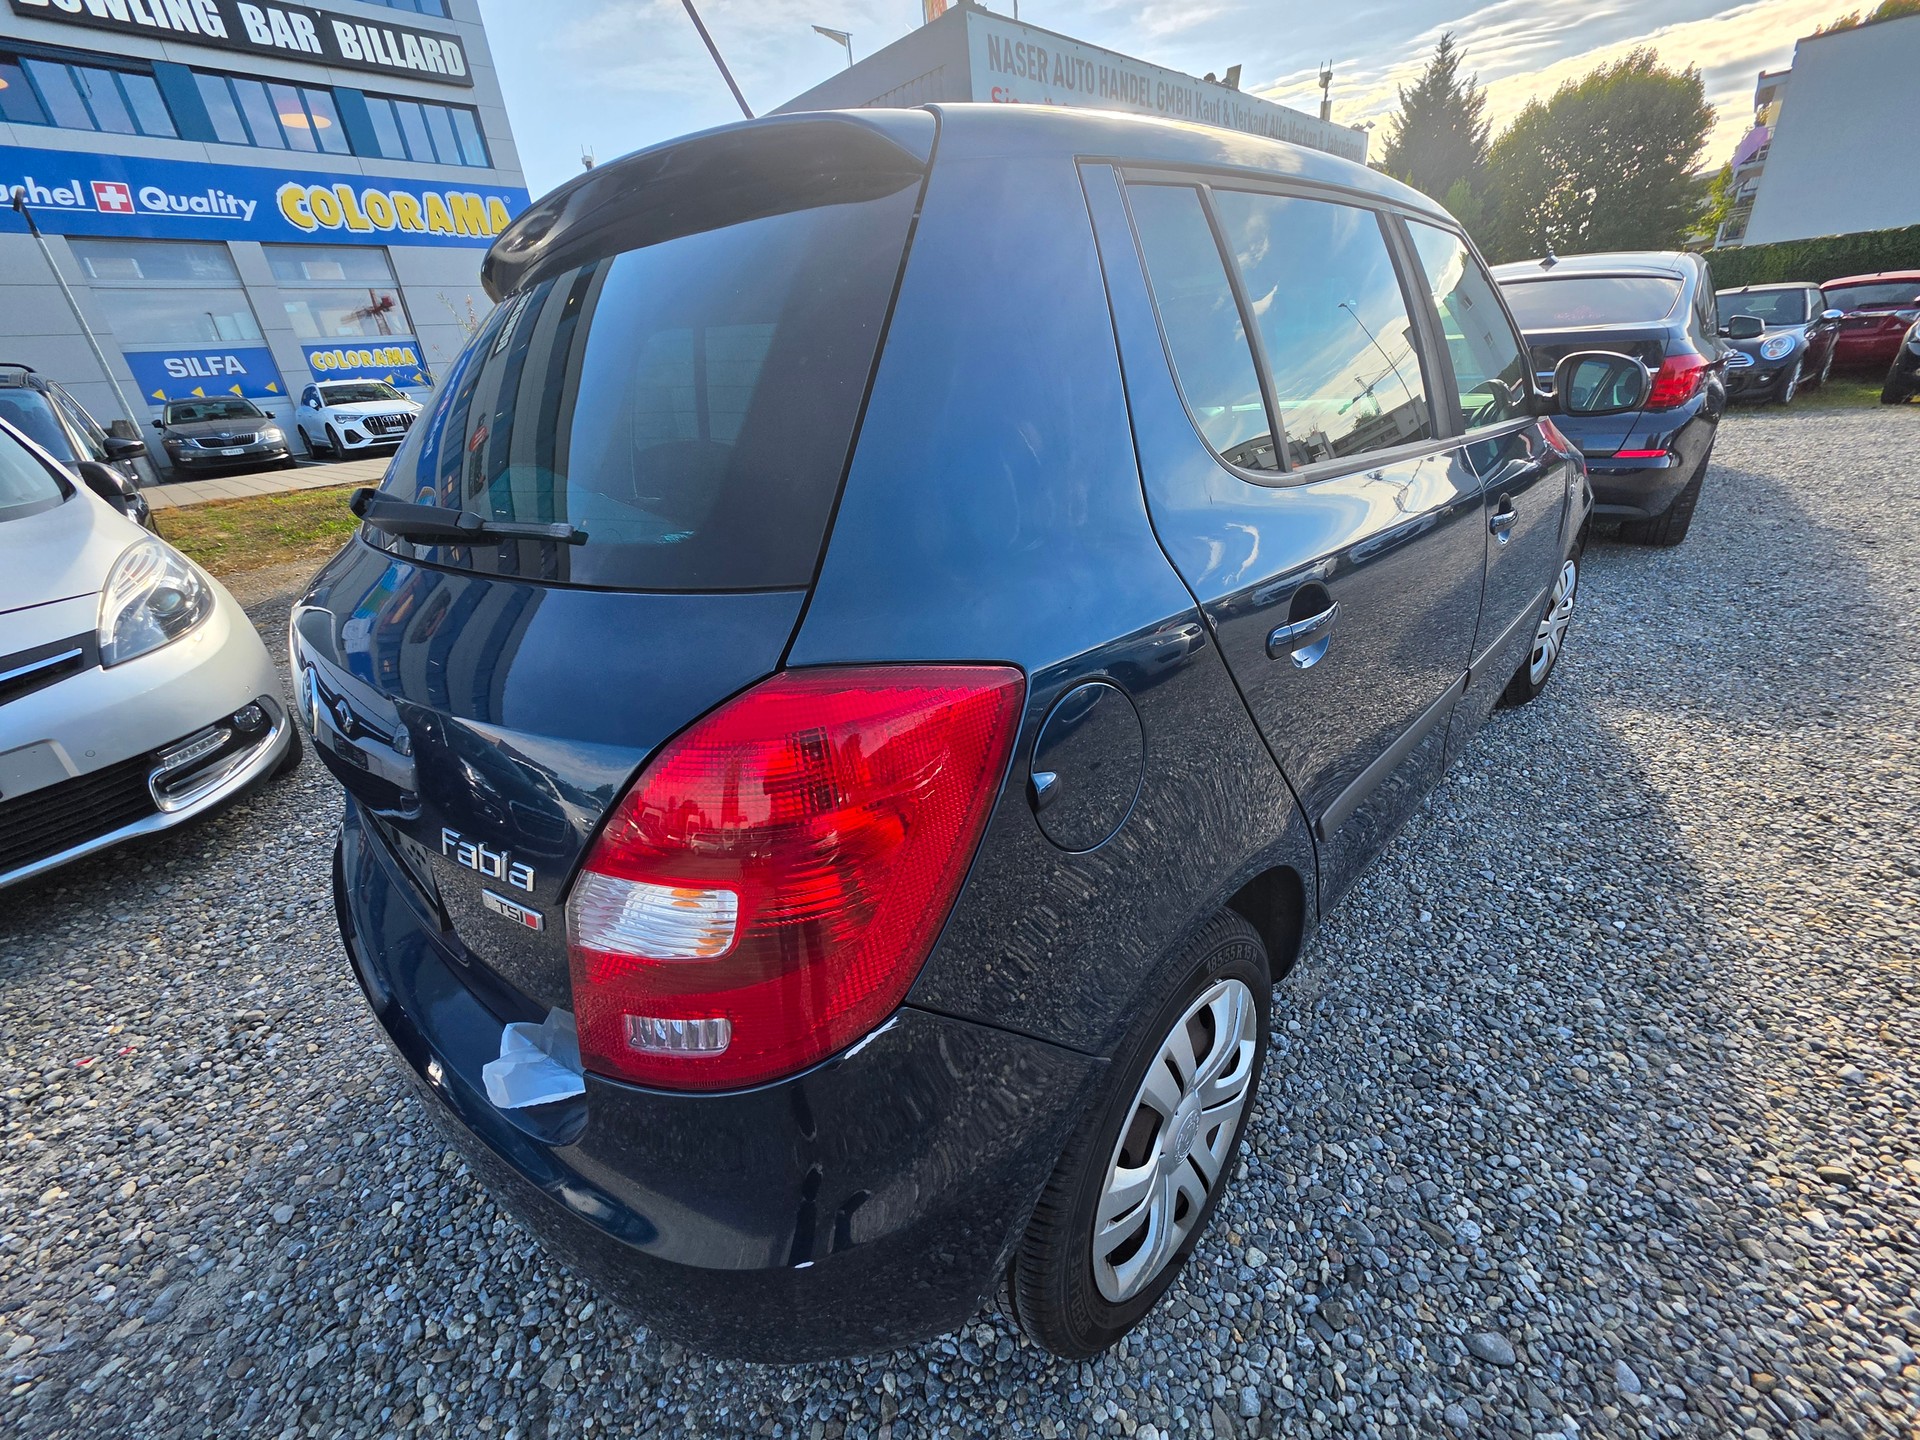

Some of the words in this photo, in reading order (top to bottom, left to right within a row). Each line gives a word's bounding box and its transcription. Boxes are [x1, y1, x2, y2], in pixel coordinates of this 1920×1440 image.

[19, 0, 229, 38] WLING
[334, 20, 467, 77] BILLARD
[987, 33, 1049, 84] NASER
[1053, 53, 1095, 94] AUTO
[1099, 65, 1153, 109] HANDEL
[1156, 81, 1192, 117] GMBH
[1196, 92, 1221, 124] Kauf
[1223, 100, 1230, 127] &
[1232, 102, 1268, 136] Verkauf
[1269, 115, 1287, 141] Alle
[1289, 120, 1318, 147] Marken
[139, 186, 257, 221] Quality
[164, 355, 248, 378] SILFA
[441, 827, 535, 892] Fabia
[496, 900, 524, 923] TSI
